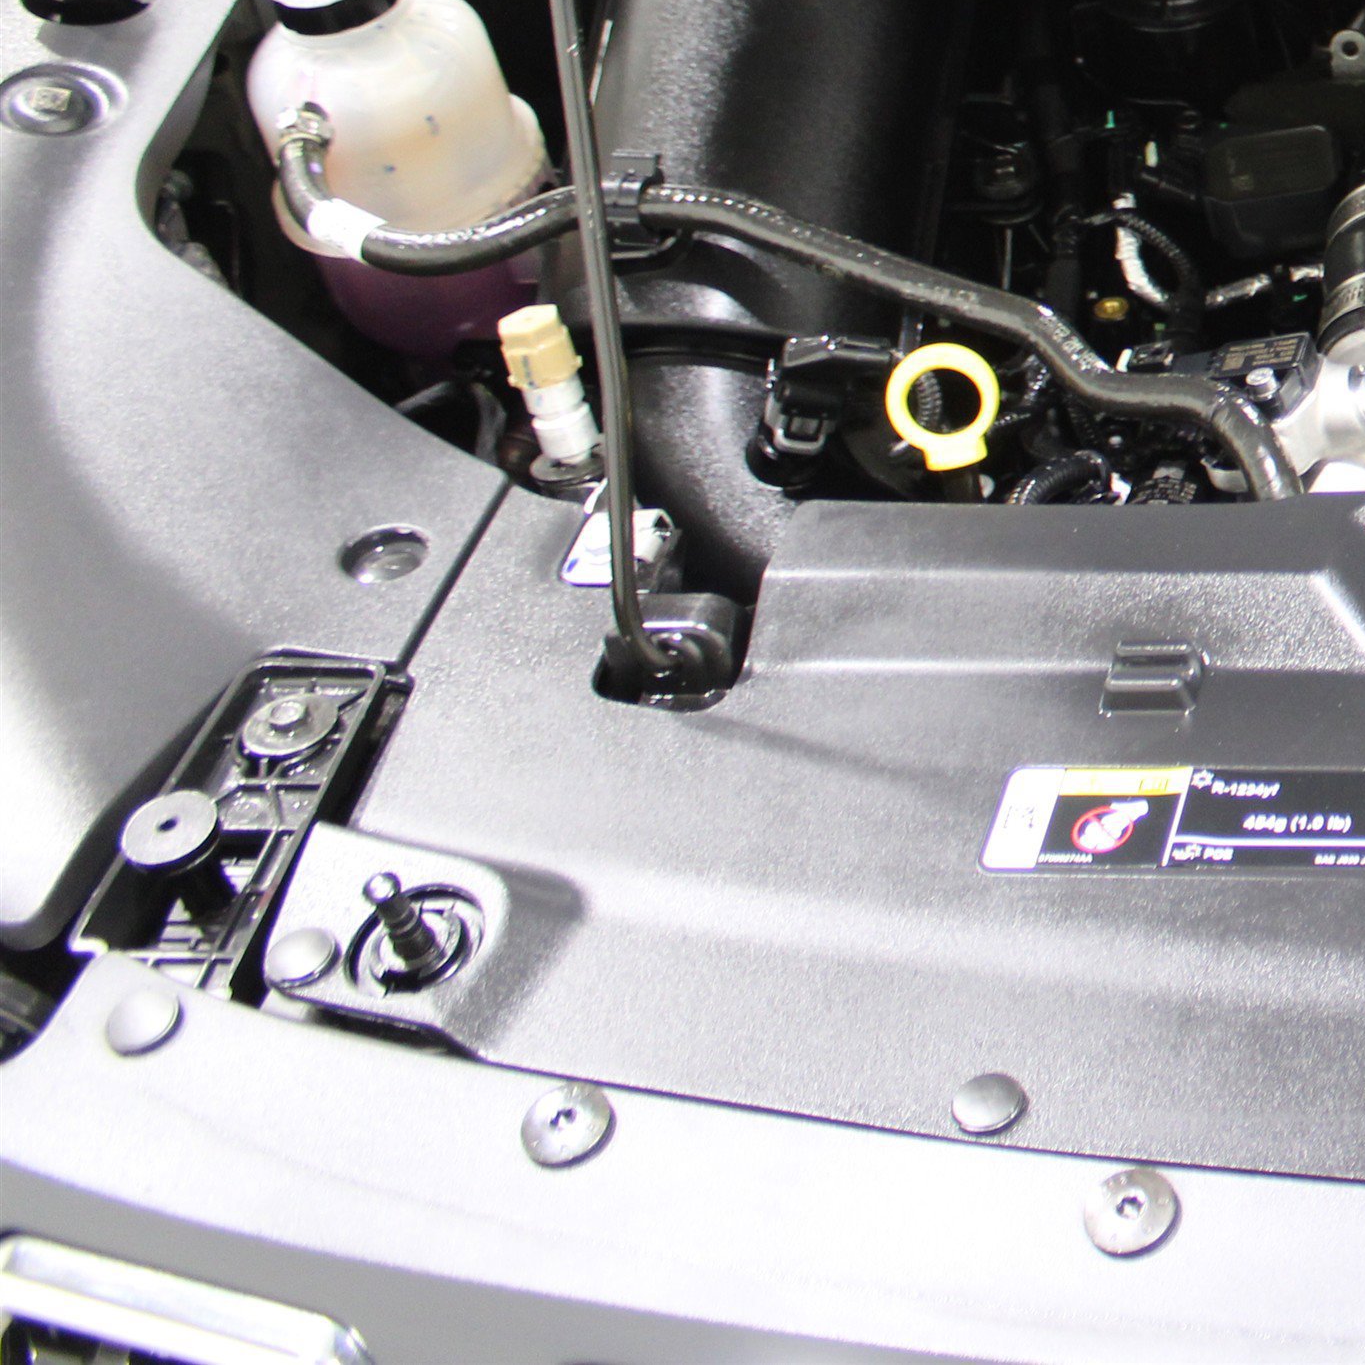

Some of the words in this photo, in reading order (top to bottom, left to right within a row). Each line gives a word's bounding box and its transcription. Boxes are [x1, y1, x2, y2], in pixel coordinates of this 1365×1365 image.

[1211, 780, 1280, 799] R-1234yf
[1289, 813, 1325, 833] (1.0
[1326, 814, 1352, 834] lb)
